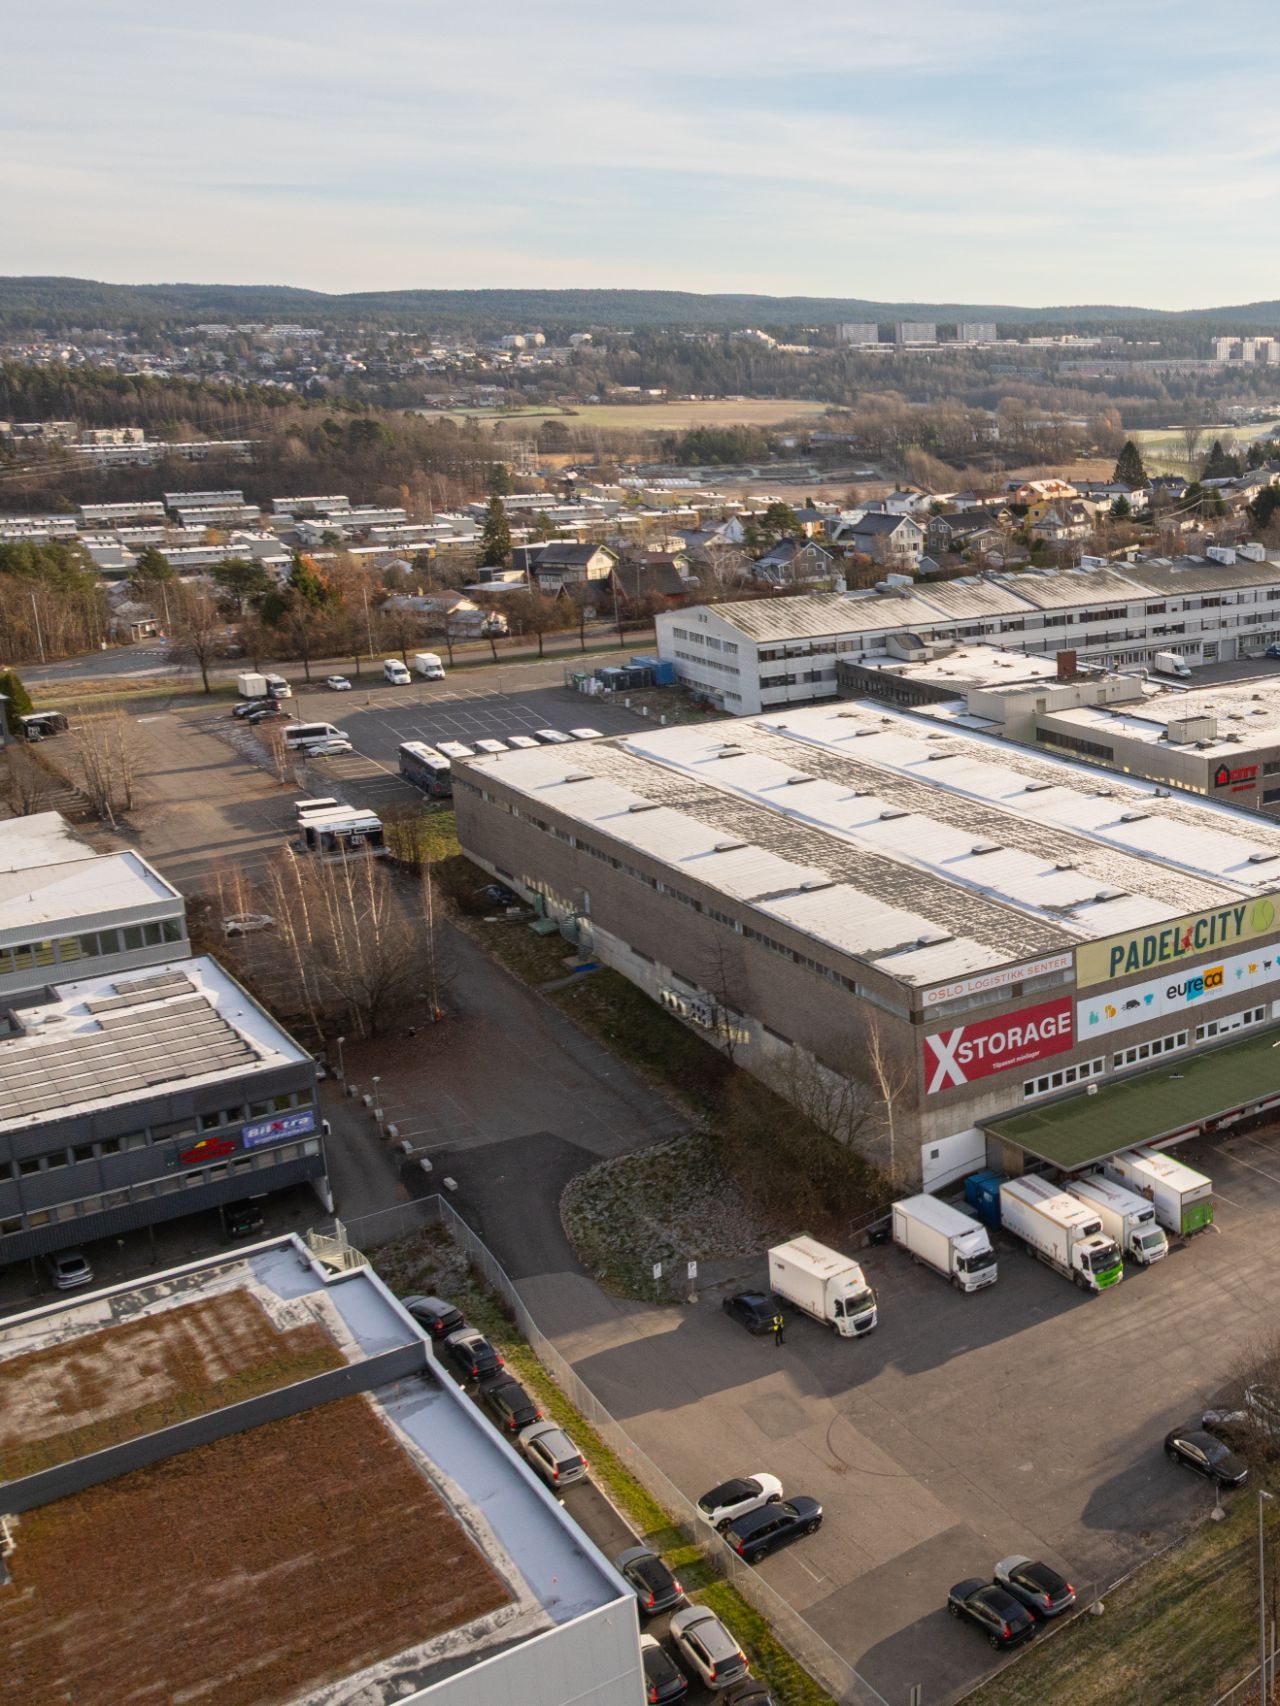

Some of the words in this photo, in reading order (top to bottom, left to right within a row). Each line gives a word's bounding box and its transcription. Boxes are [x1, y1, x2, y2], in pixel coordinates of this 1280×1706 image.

[1110, 926, 1186, 978] PADEL
[1193, 905, 1246, 949] CITY
[927, 984, 964, 1002] OSLO
[967, 967, 1024, 992] LOGISTIKK
[1027, 957, 1068, 975] SENTER
[1166, 970, 1224, 999] eureca
